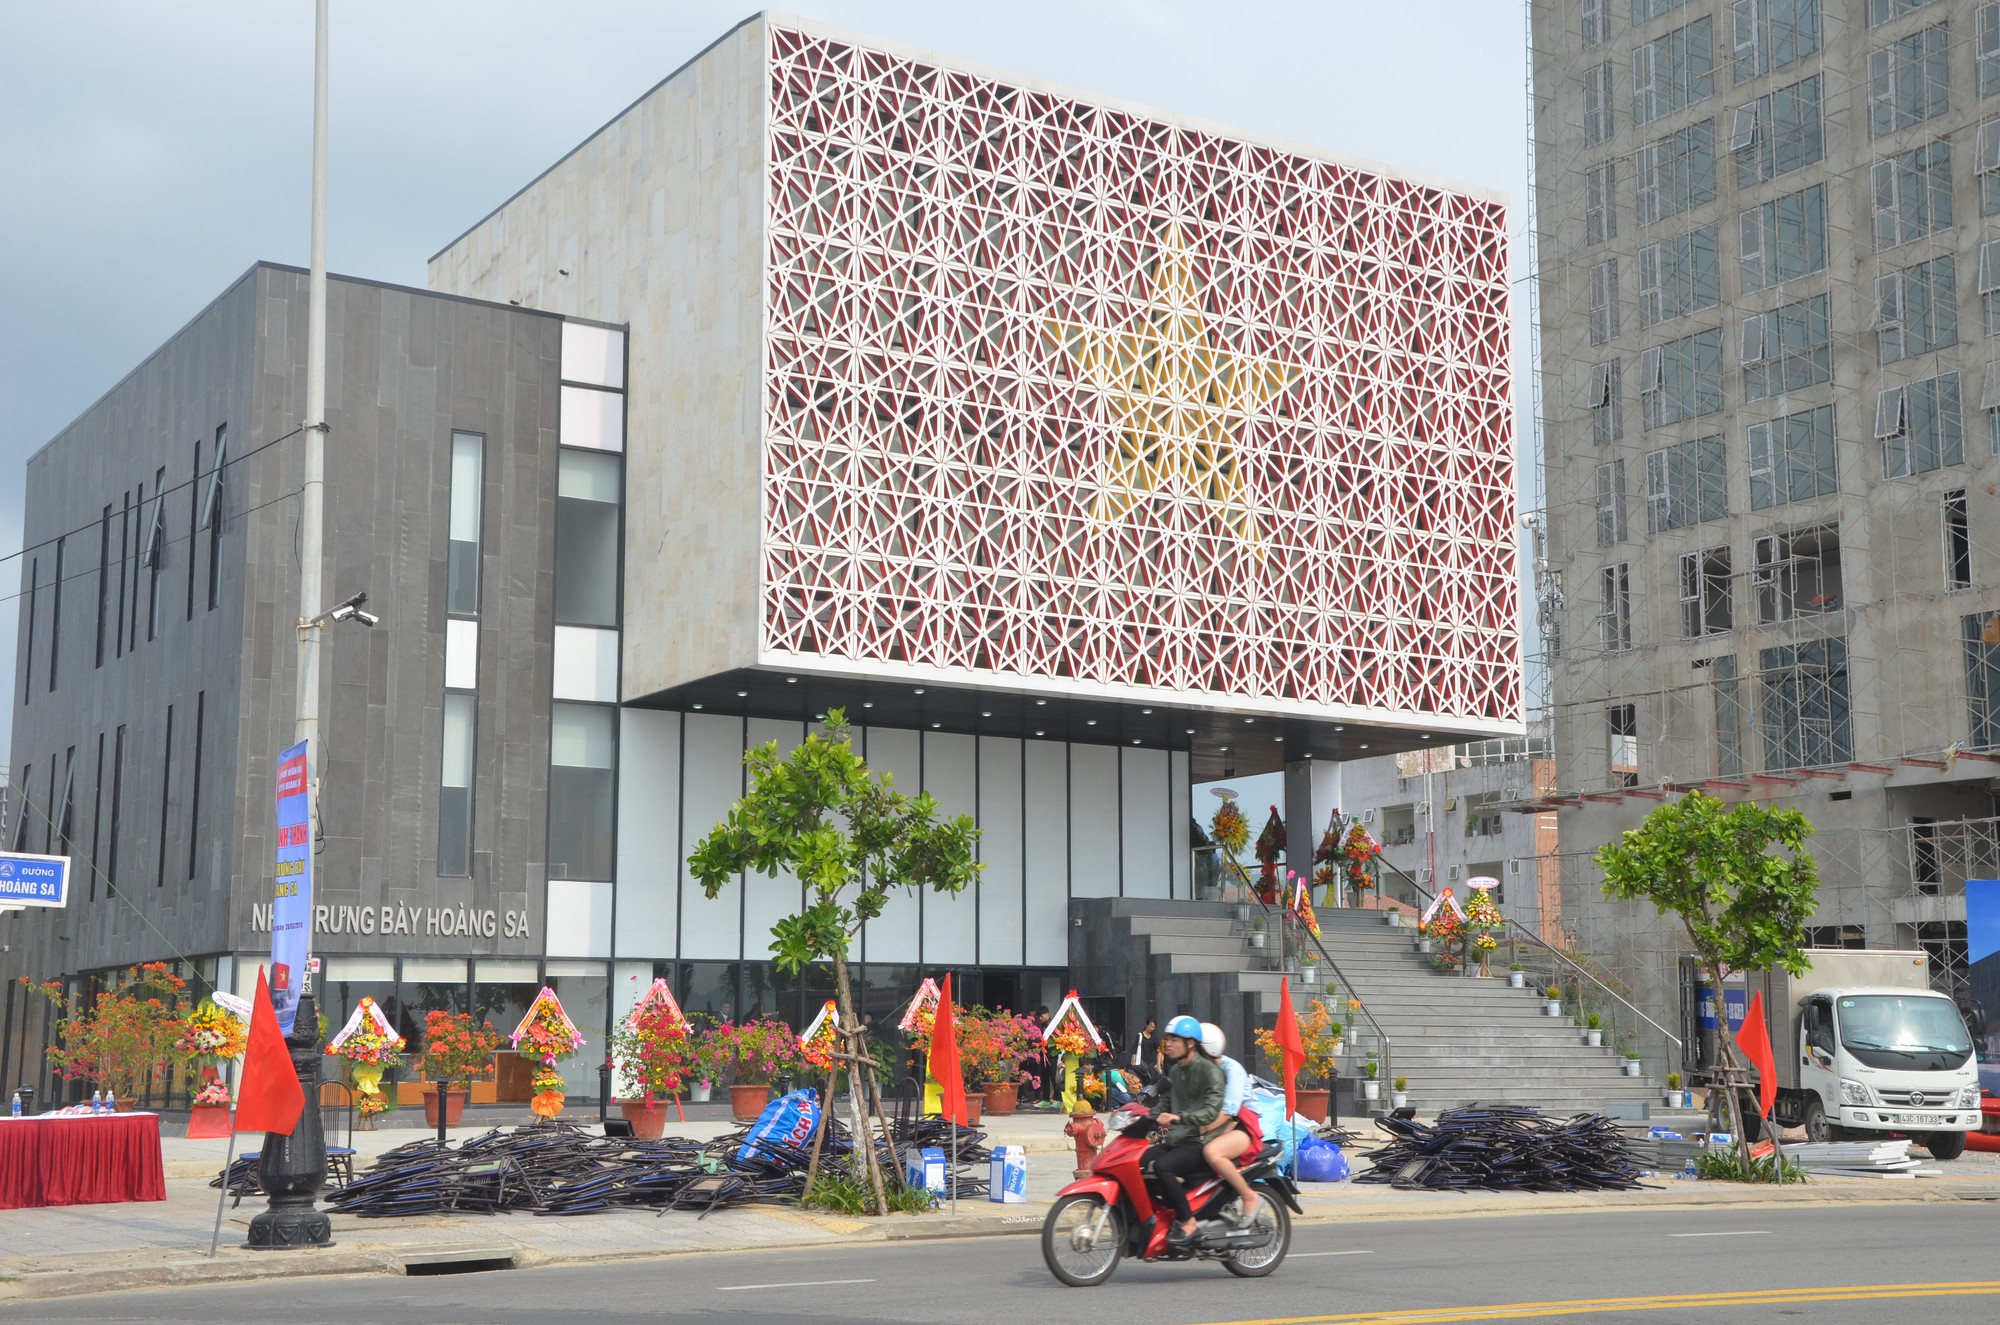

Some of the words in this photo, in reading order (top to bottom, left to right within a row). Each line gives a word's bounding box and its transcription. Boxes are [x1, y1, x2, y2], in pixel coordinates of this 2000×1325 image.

[21, 867, 55, 877] ĐƯỜNG
[276, 859, 293, 877] RƯNG
[0, 878, 37, 894] HOÀNG
[40, 883, 55, 896] SA
[274, 881, 289, 898] ÀNG
[312, 904, 375, 935] RƯNG
[380, 900, 422, 935] BÀY
[426, 902, 496, 938] HOÀNG
[504, 909, 530, 938] SA
